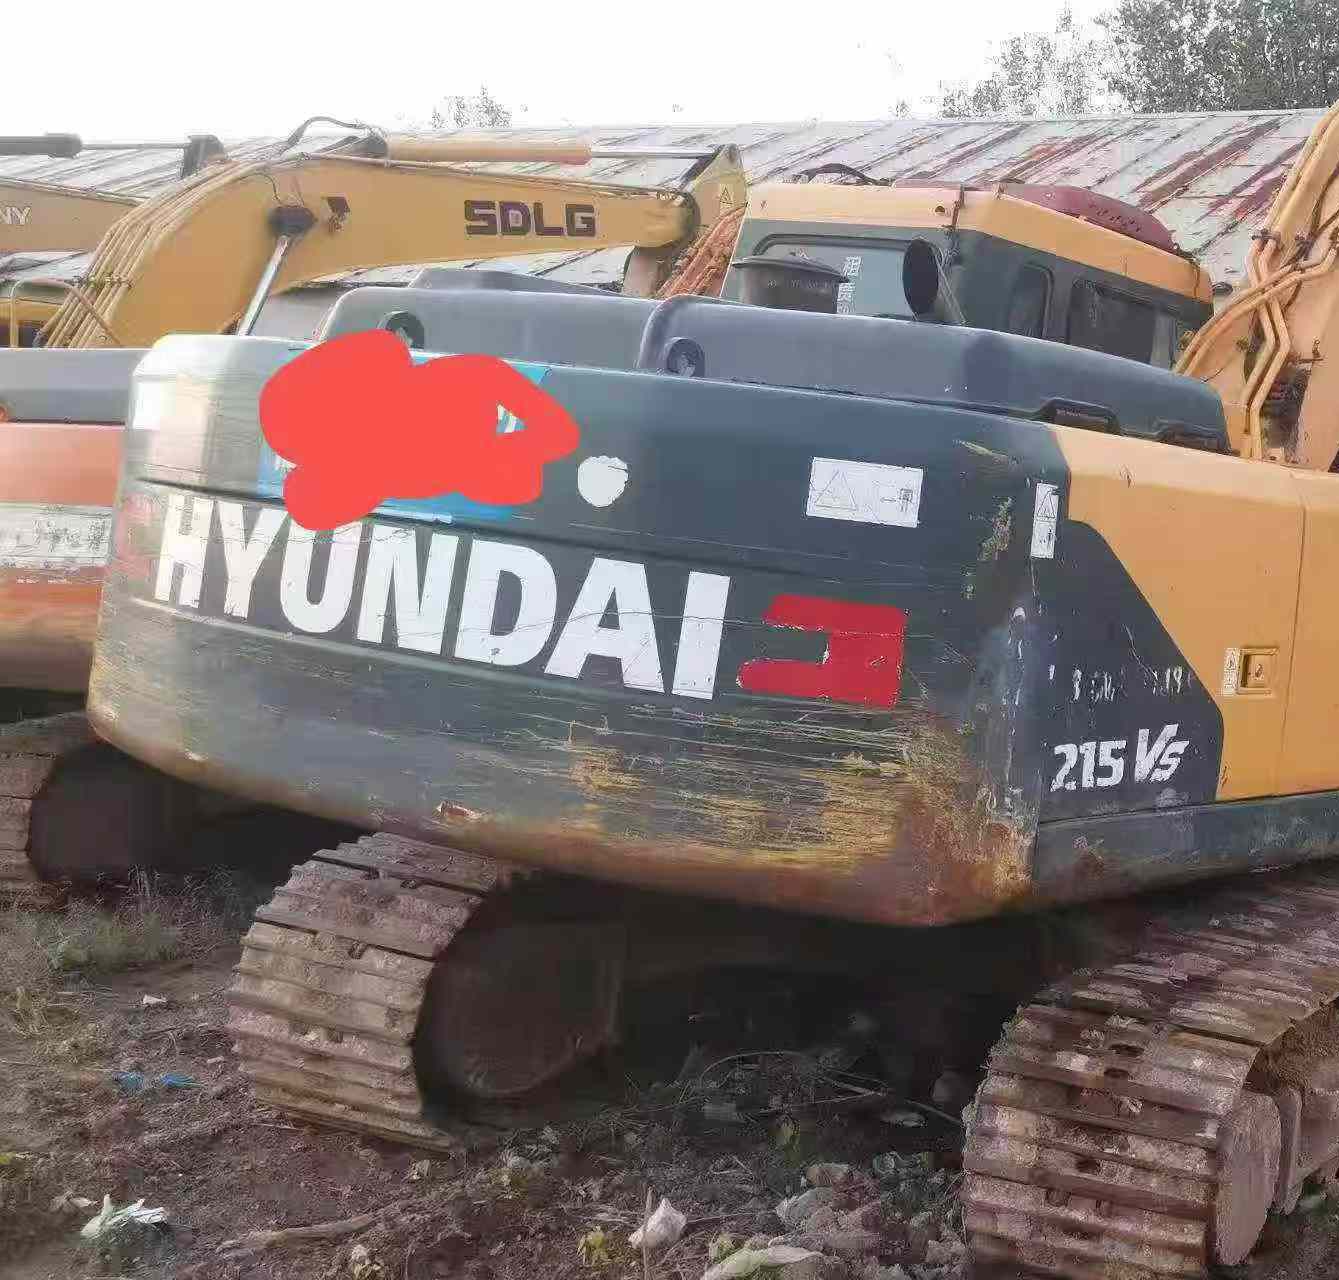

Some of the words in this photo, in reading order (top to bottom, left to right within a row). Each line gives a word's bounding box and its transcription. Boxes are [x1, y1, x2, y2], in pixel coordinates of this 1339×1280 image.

[464, 199, 596, 237] SDLG
[154, 492, 732, 701] HYUNDAI
[1050, 739, 1127, 792] 215
